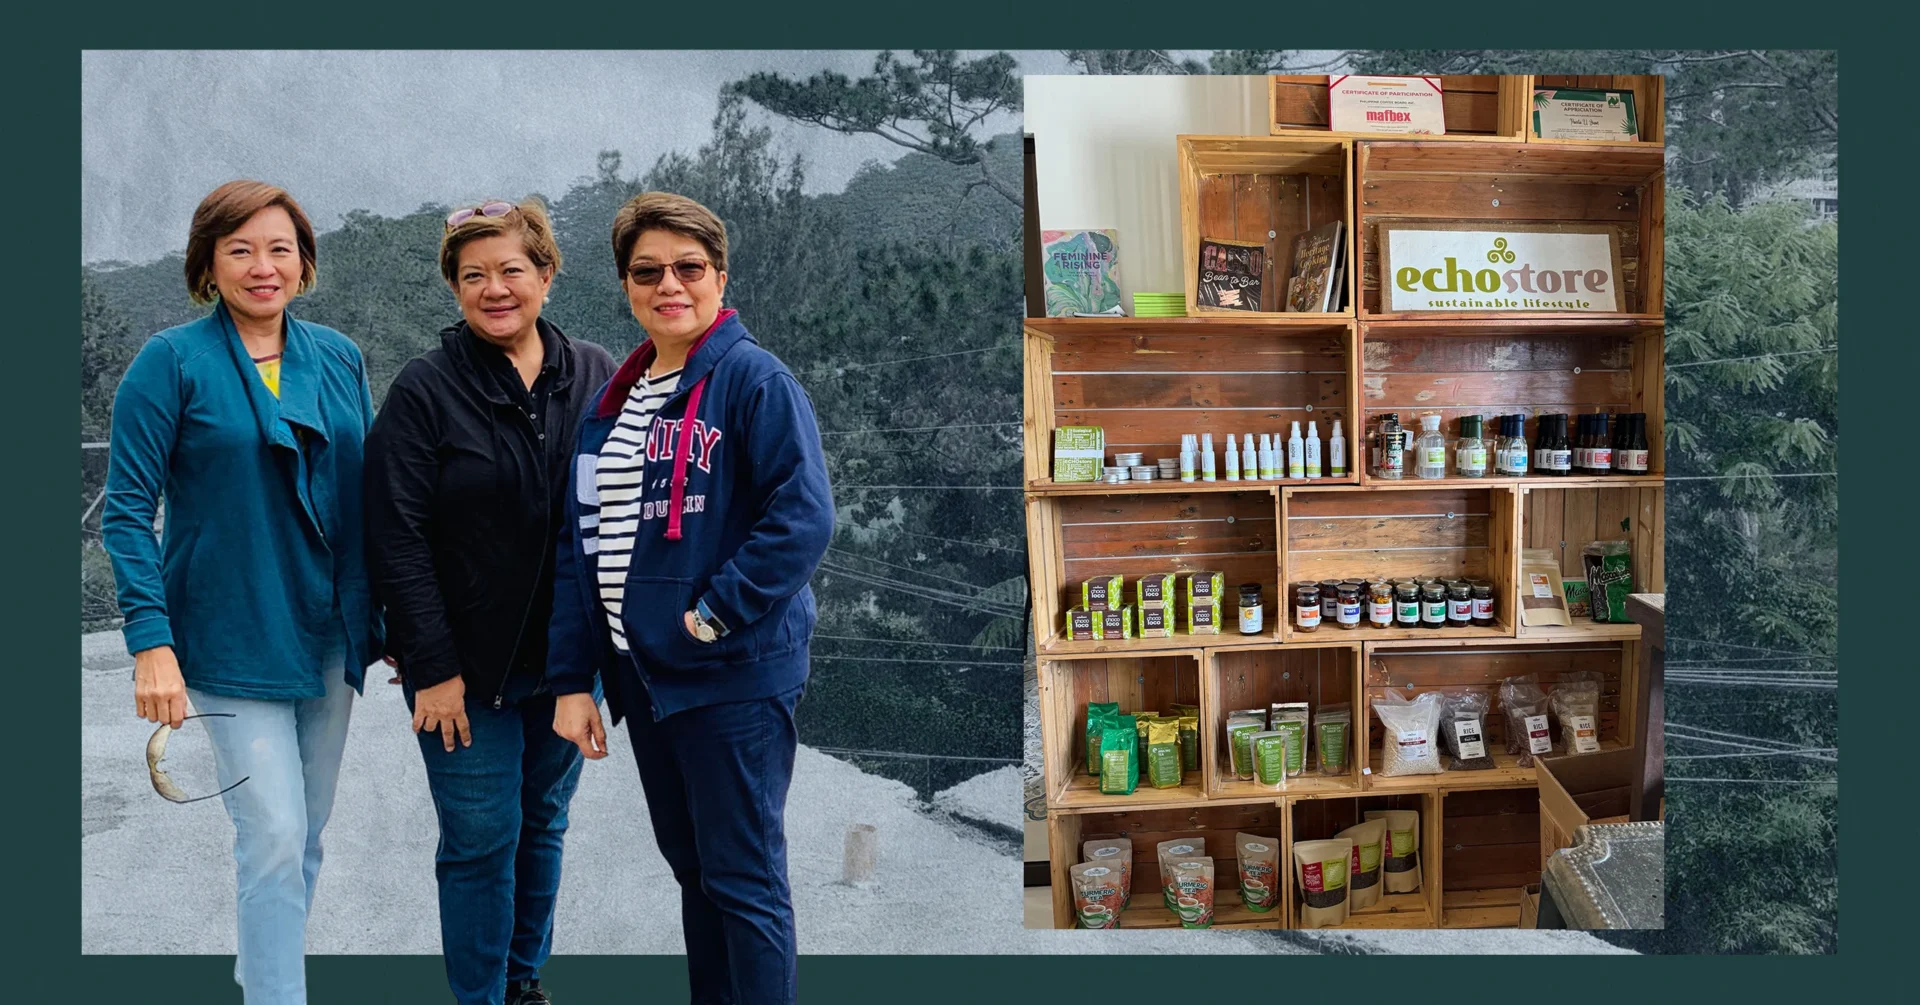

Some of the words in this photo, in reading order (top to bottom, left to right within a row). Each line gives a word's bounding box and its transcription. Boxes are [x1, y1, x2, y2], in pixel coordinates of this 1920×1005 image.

[1366, 109, 1412, 122] mafbex
[1053, 252, 1108, 261] FEMININE
[1300, 244, 1330, 259] Heritage
[1062, 261, 1101, 270] RISING
[1300, 254, 1328, 270] Cooking
[1203, 271, 1229, 283] Bean
[1230, 276, 1239, 284] to
[1239, 276, 1260, 288] Bar
[1396, 256, 1609, 295] echostore
[1428, 297, 1518, 309] sustainable
[1524, 298, 1590, 309] lifestyle
[652, 477, 689, 490] 152
[643, 495, 706, 520] DUIN
[1242, 864, 1273, 874] TURMERIC
[1177, 881, 1208, 890] TURMERIC
[1080, 888, 1116, 898] TURMERIC
